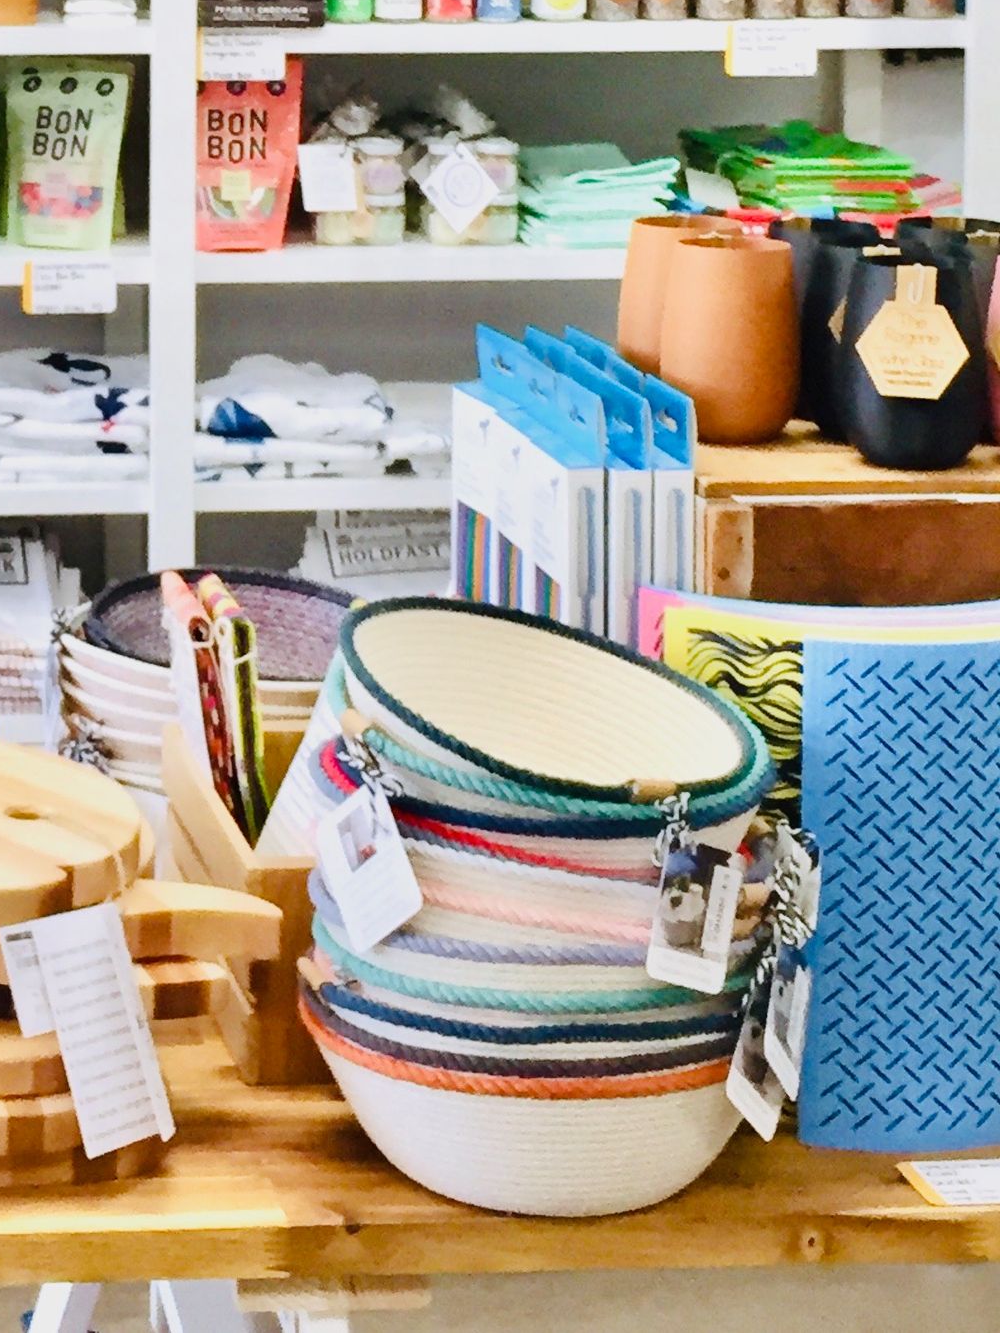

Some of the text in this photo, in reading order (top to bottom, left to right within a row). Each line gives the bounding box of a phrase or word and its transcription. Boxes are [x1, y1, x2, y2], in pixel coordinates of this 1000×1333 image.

[36, 105, 93, 134] BON
[208, 109, 268, 136] BON
[32, 132, 88, 160] BON
[208, 135, 266, 164] BON
[338, 544, 442, 565] HOLDFAST
